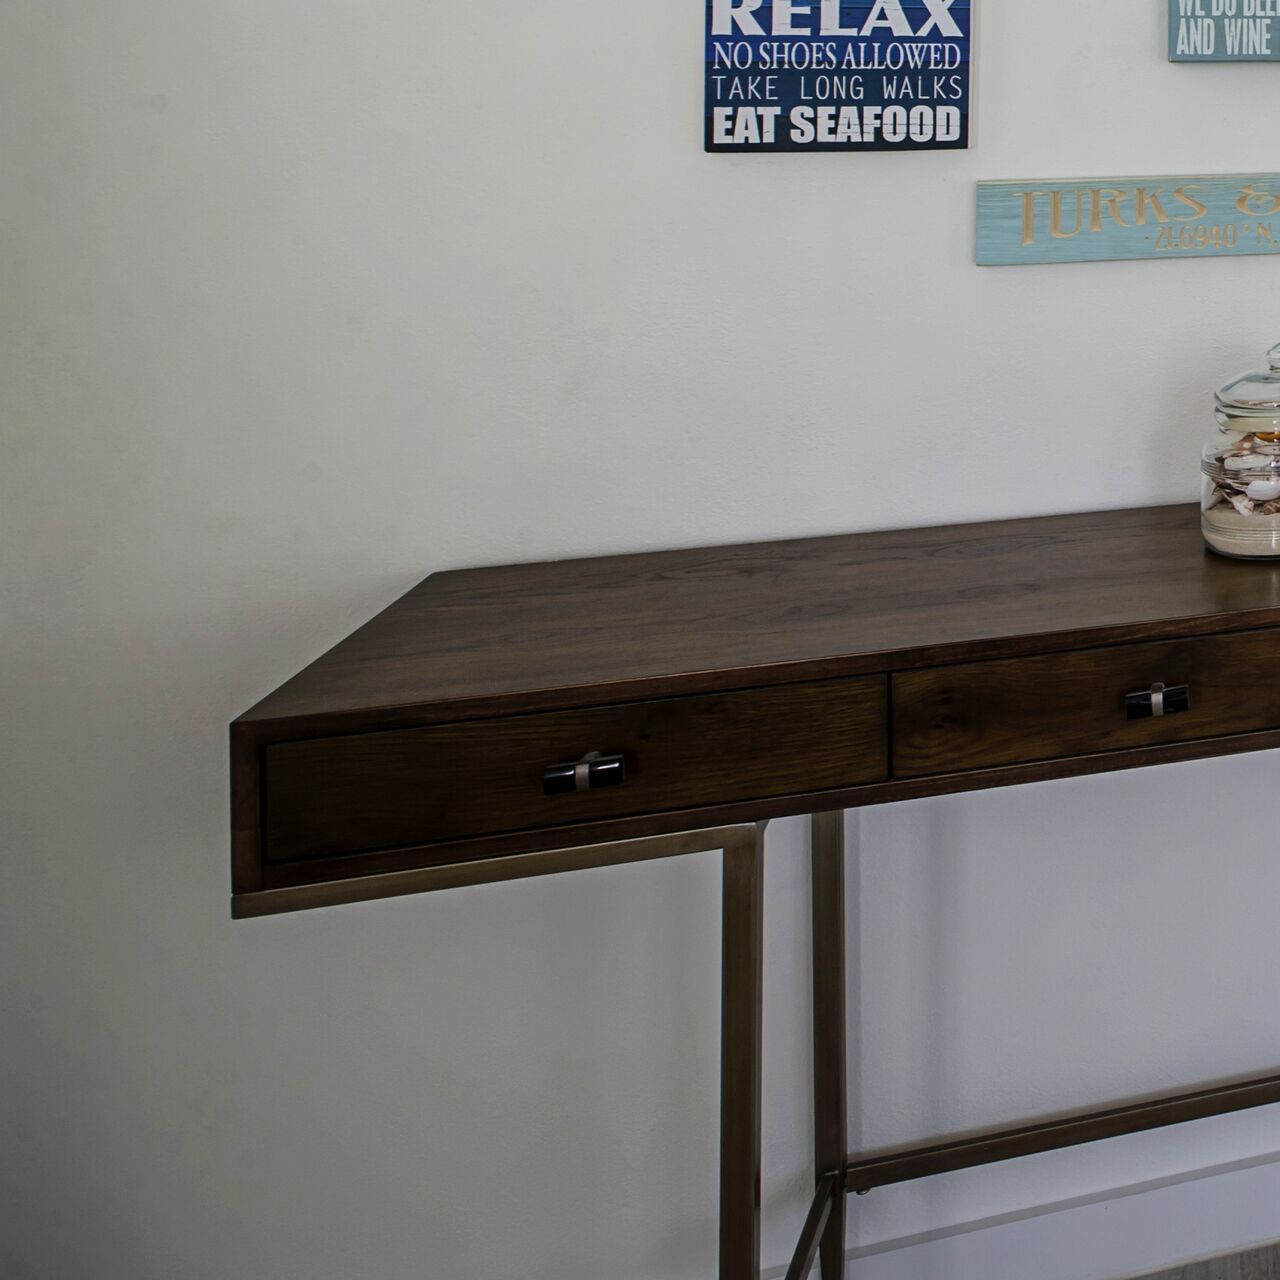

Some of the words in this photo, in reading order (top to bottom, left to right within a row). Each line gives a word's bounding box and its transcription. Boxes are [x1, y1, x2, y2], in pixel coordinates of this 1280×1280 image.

[1176, 18, 1215, 55] AND
[1224, 18, 1271, 54] WINE
[713, 42, 752, 69] NO
[759, 42, 836, 69] SHOES
[842, 42, 960, 70] ALLOWED
[713, 76, 778, 100] TAKE
[800, 76, 863, 100] LONG
[882, 76, 962, 100] WALKS
[714, 106, 781, 144] EAT
[789, 105, 960, 144] SEAFOOD
[1010, 184, 1207, 247] TURKS
